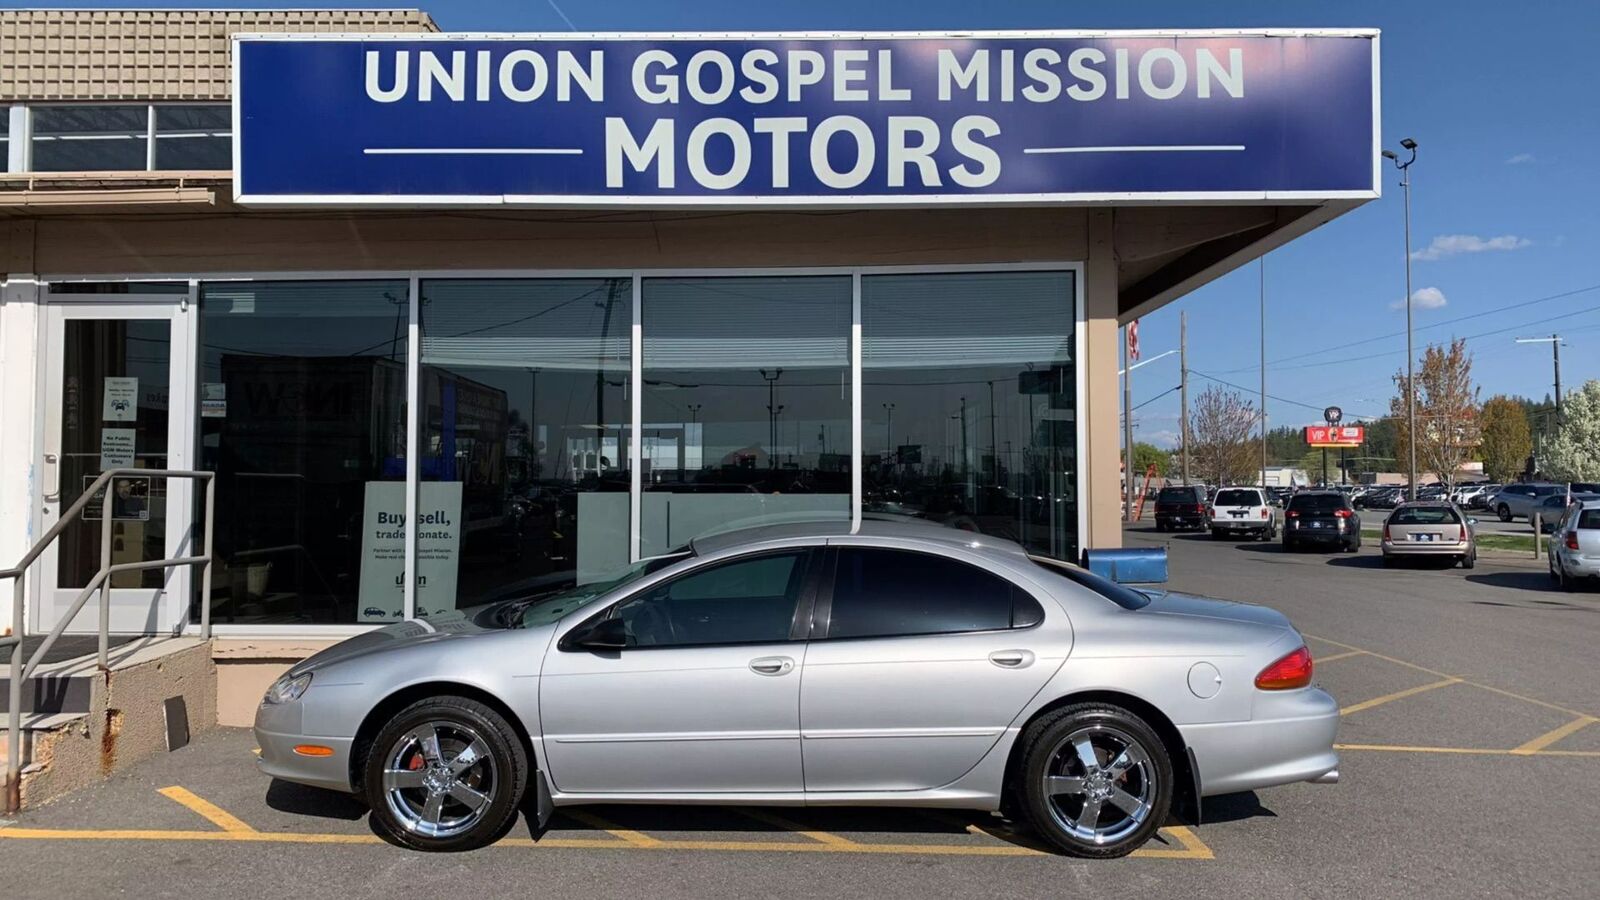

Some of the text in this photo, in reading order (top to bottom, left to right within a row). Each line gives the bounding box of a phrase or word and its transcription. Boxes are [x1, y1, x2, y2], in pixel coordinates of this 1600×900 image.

[366, 47, 1245, 105] UNION GOSPEL MISSION
[605, 115, 1003, 191] MOTORS
[1312, 431, 1325, 440] VIP
[418, 510, 451, 526] sell,
[418, 530, 452, 539] onate.
